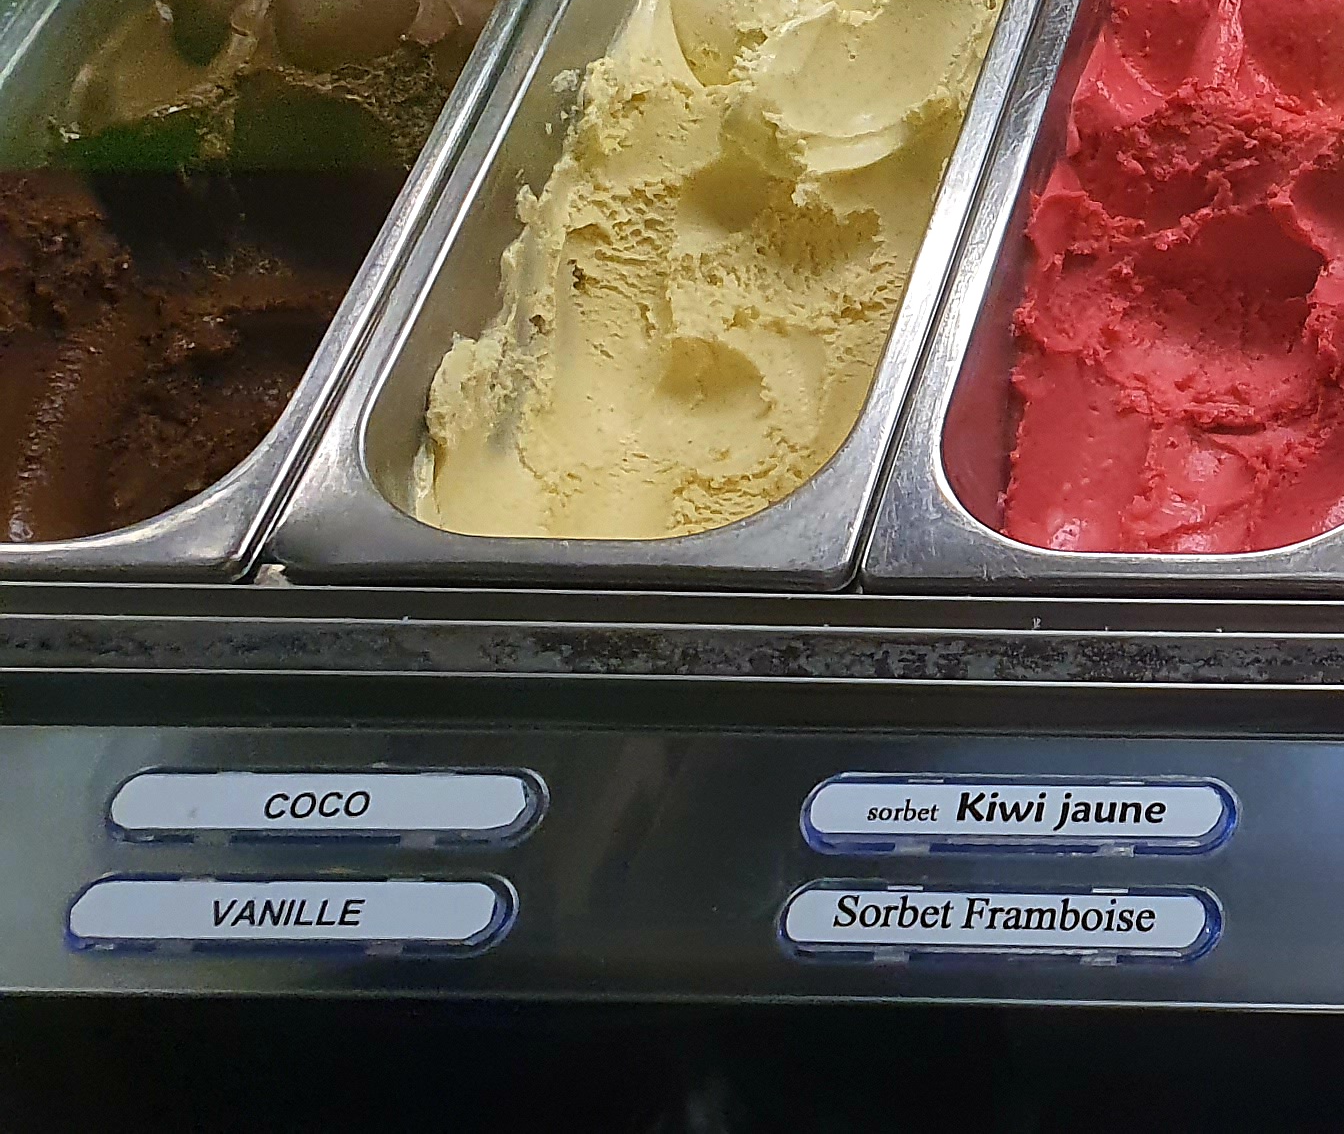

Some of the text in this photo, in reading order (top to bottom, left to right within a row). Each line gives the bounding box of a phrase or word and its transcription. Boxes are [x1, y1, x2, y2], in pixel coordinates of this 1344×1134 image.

[264, 792, 371, 819] COCO
[867, 791, 1167, 831] sorbet Kiwi jaune
[213, 900, 367, 926] VANILLE
[832, 895, 1157, 933] Sorbet Framboise
